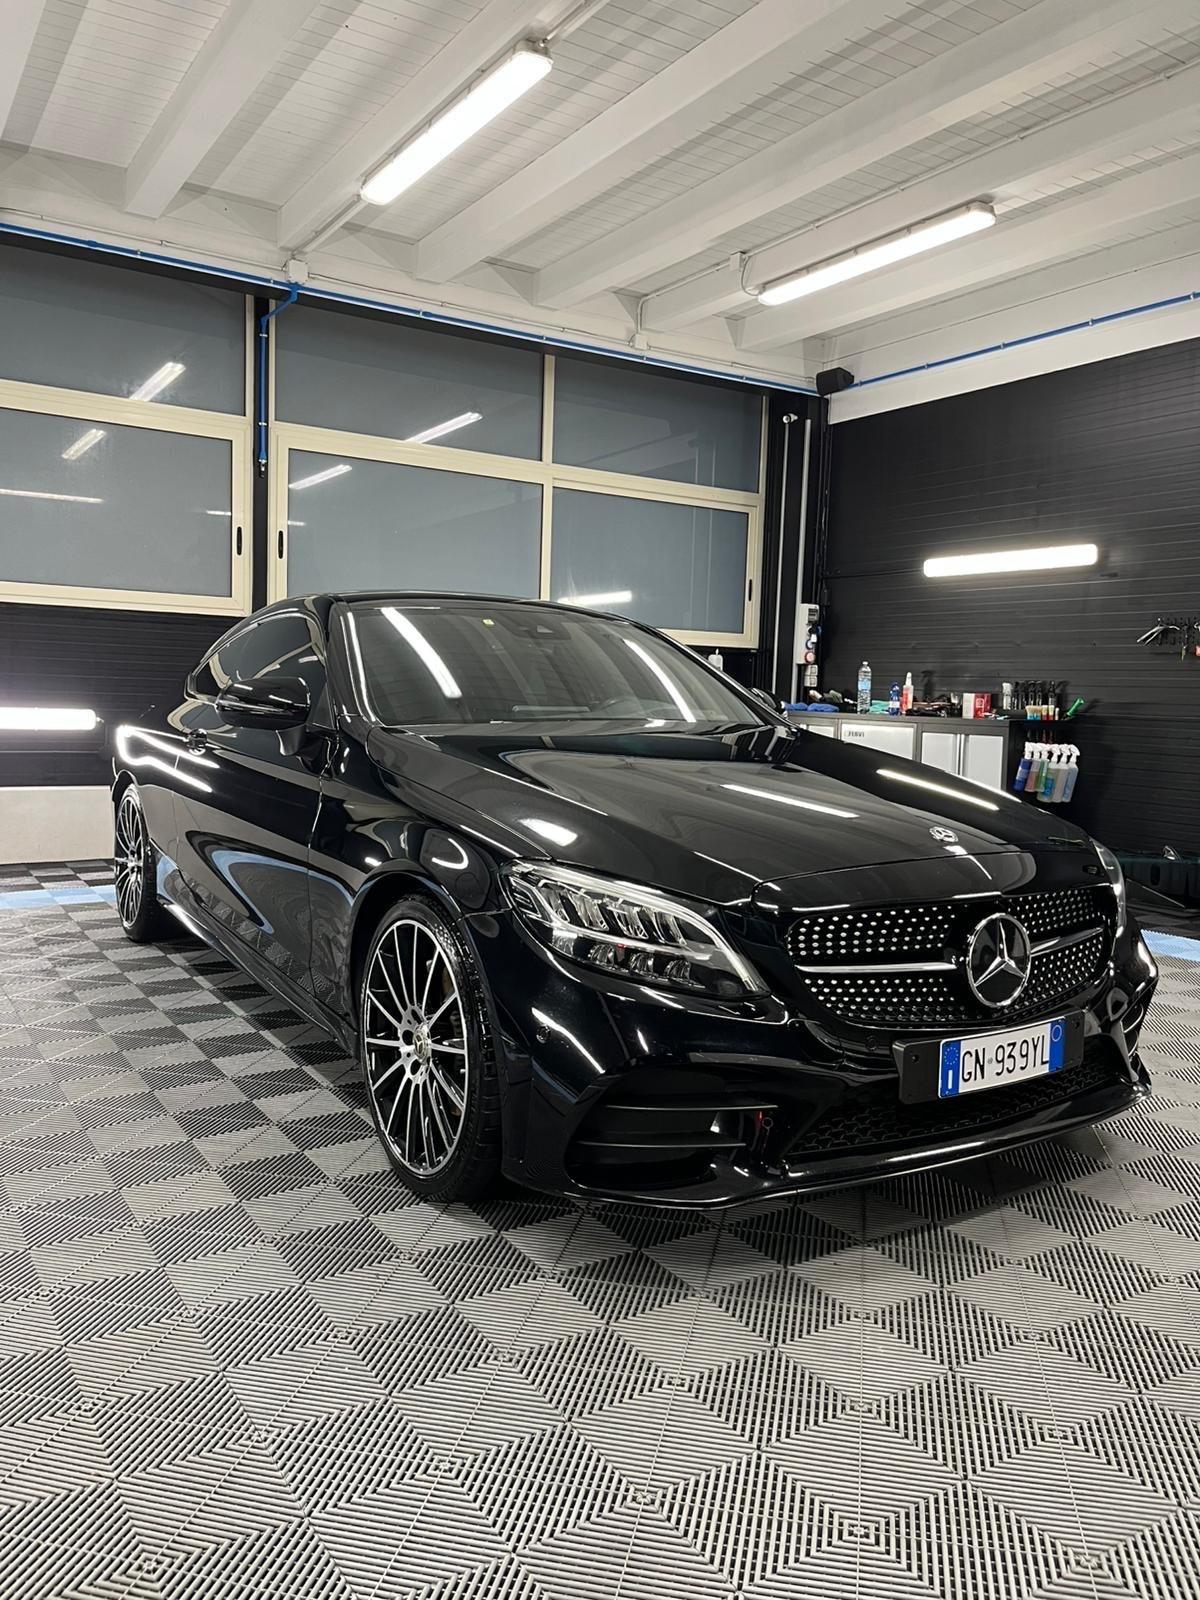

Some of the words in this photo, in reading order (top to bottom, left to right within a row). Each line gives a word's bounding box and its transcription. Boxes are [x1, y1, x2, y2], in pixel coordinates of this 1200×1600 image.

[961, 1047, 985, 1082] GN
[995, 1035, 1050, 1076] 939YL
[948, 1070, 953, 1089] I
